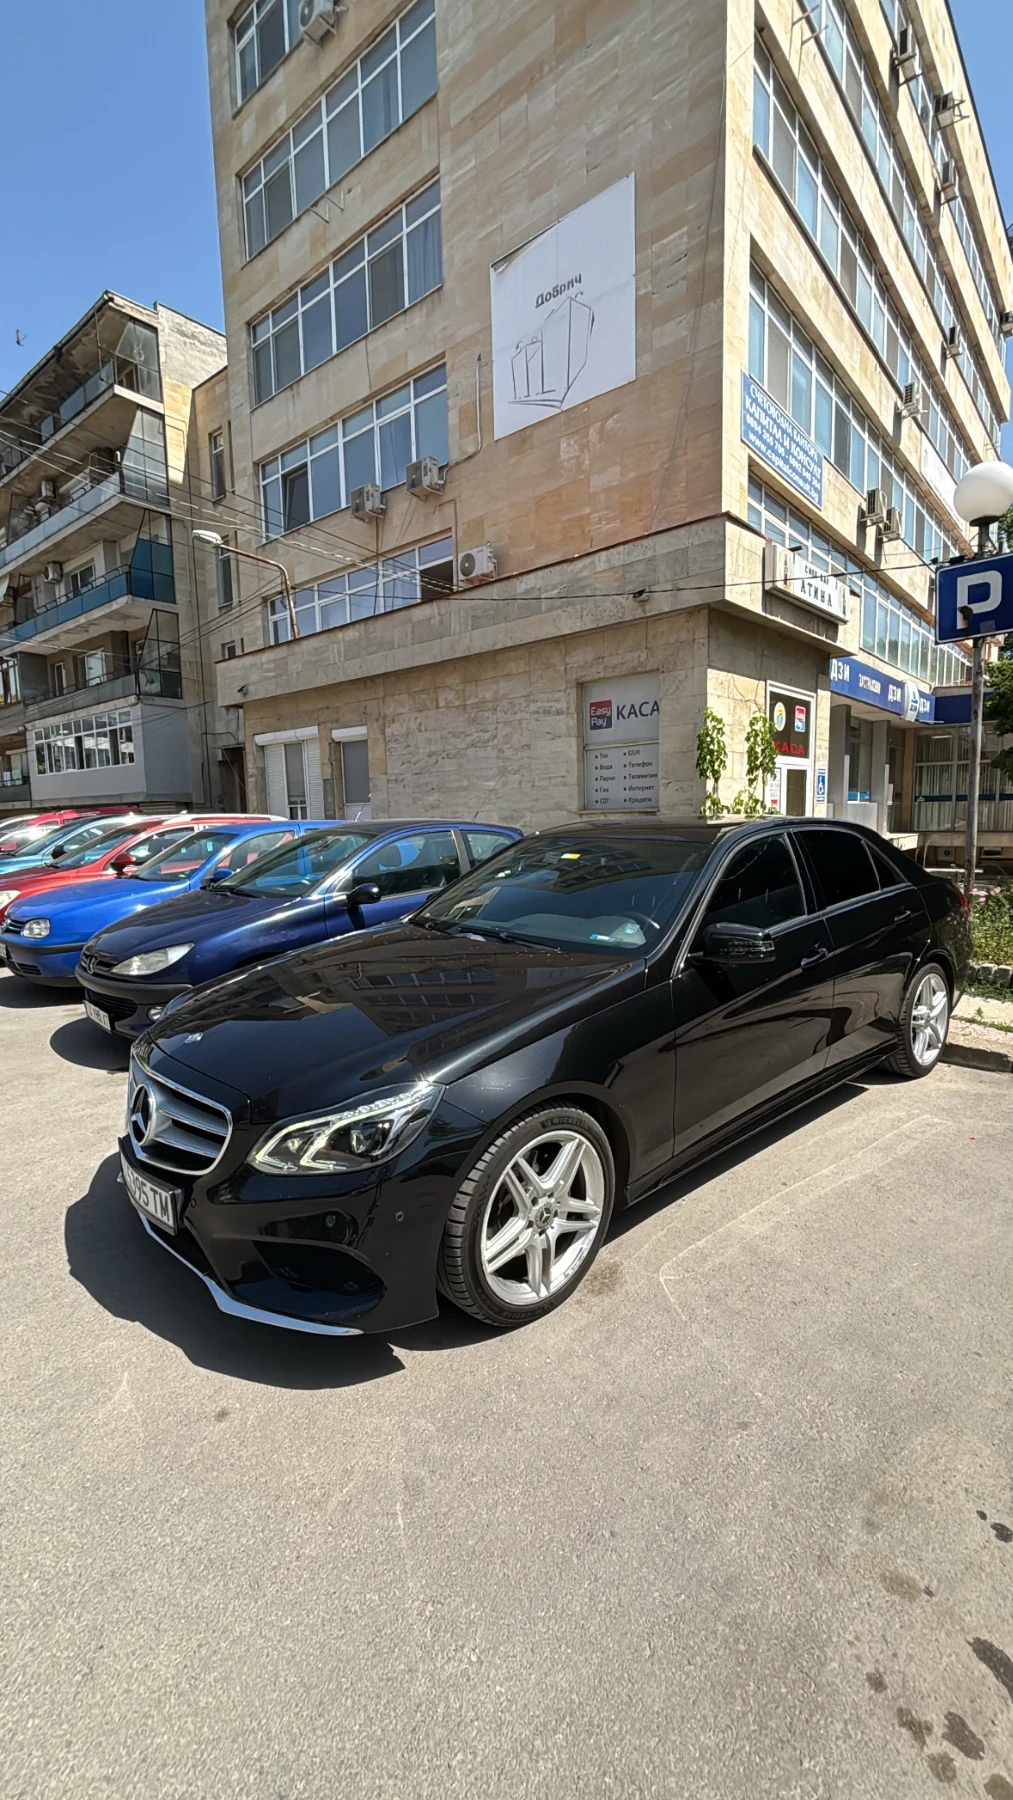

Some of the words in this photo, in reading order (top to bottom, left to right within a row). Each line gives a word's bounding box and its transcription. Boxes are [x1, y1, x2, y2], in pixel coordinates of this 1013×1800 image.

[535, 273, 581, 308] Добрич
[745, 394, 782, 442] КАПИТАЛ
[783, 434, 790, 449] И
[791, 440, 821, 479] КОНСУЛТ
[793, 428, 818, 462] КАНТОРА
[800, 579, 832, 607] АТИНА
[957, 570, 1002, 629] P
[830, 658, 850, 682] ДЗИ
[887, 685, 902, 703] ДЗИ
[590, 706, 611, 717] Easy
[591, 717, 607, 728] Pay
[616, 700, 660, 720] КАСА
[628, 761, 653, 769] Телефон
[149, 1187, 171, 1223] TM
